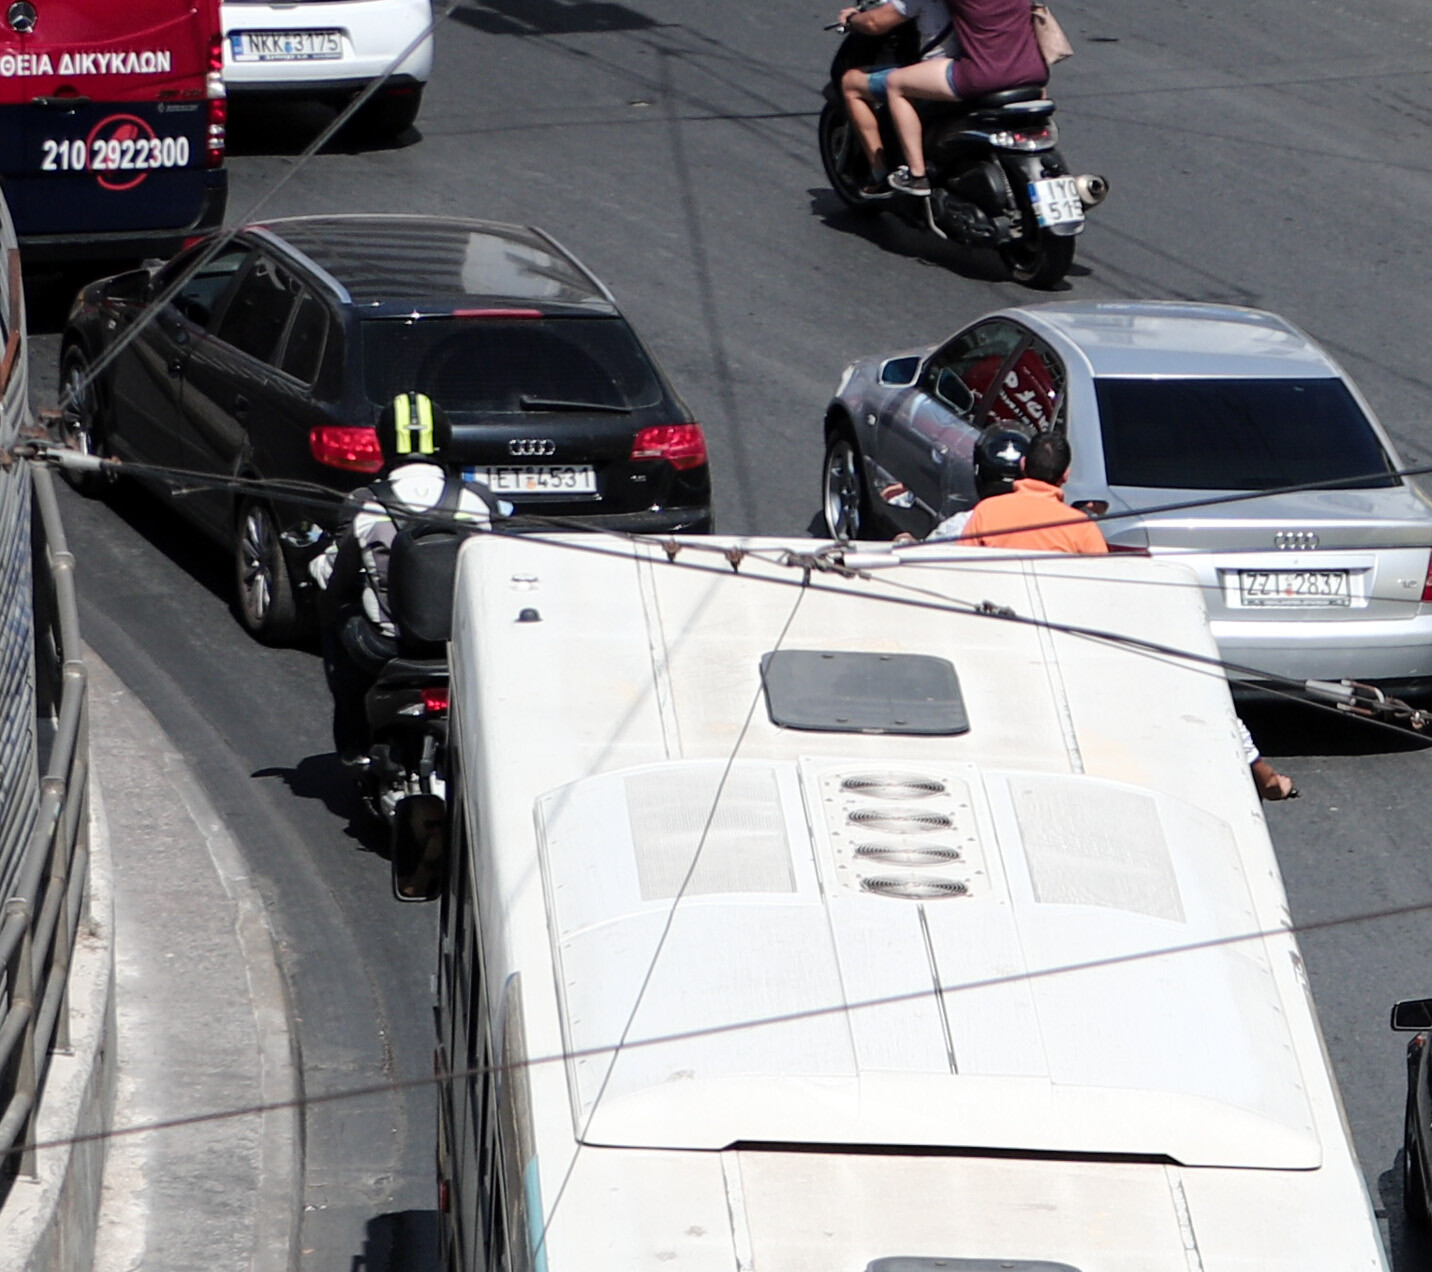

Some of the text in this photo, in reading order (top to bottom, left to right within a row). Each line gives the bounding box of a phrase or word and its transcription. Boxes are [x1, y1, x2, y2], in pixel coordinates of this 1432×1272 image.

[59, 51, 171, 75] ΔΙΚΥΚΛΩΝ
[42, 136, 190, 170] 210 2922300
